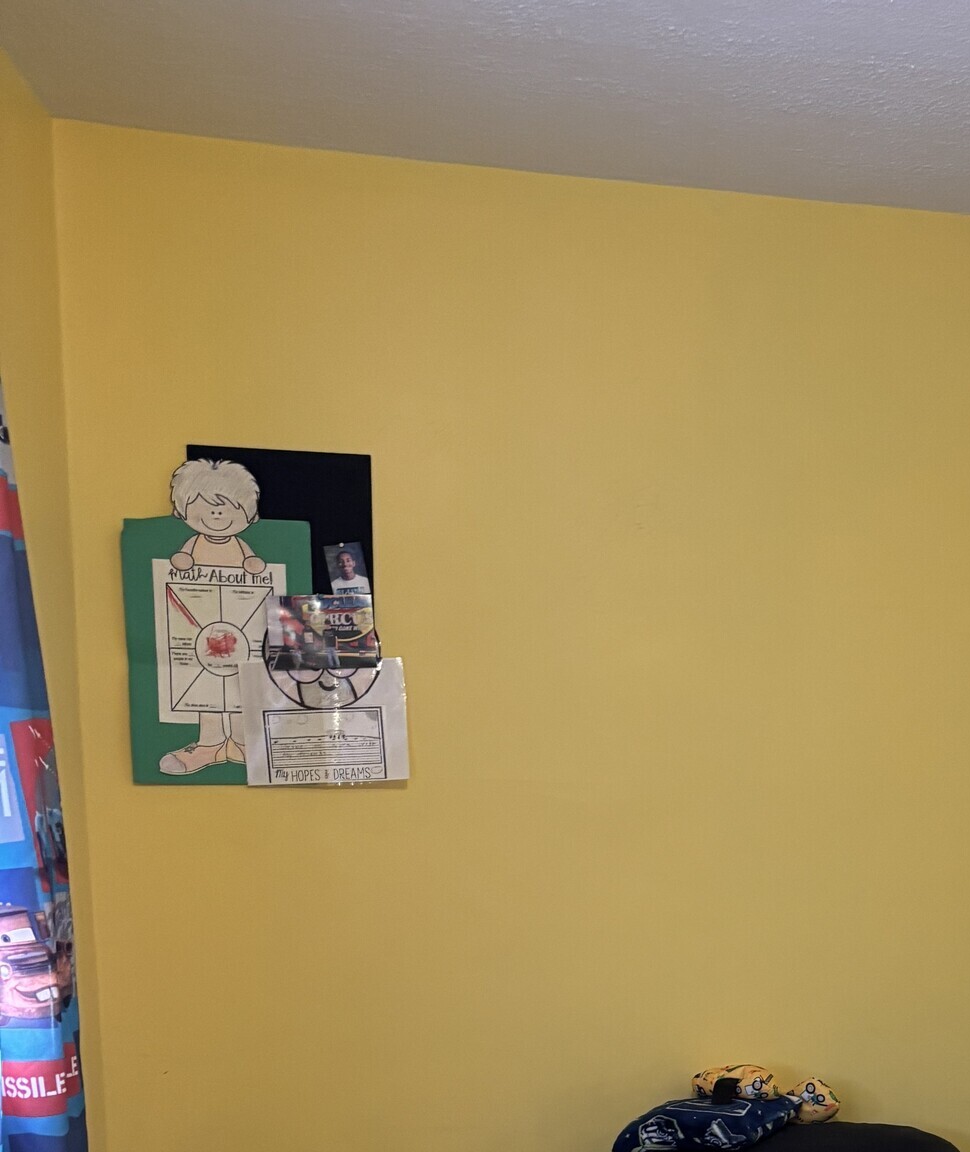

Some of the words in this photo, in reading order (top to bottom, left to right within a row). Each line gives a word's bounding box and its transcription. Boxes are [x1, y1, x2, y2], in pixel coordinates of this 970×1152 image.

[208, 569, 246, 584] About
[252, 571, 273, 585] me!
[290, 769, 321, 781] HOPES
[333, 767, 372, 780] DREAMS
